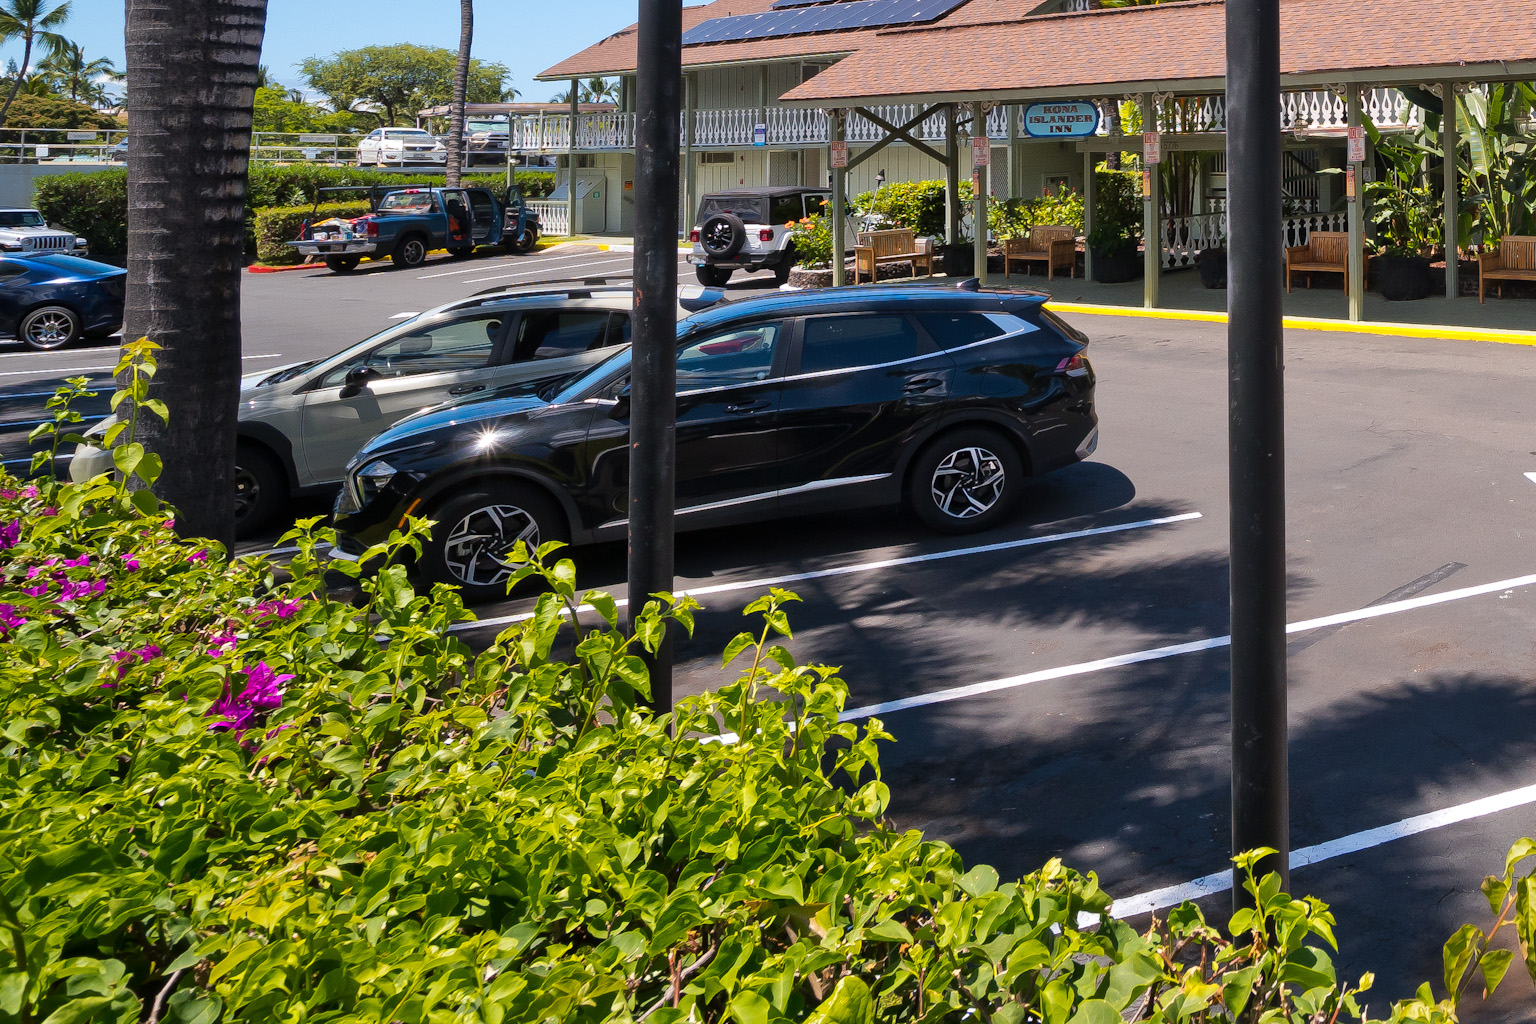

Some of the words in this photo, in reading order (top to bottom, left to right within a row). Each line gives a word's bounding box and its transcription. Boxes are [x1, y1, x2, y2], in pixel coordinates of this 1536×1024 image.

[1043, 105, 1078, 114] KONA
[1029, 115, 1093, 123] ISLANDER
[1049, 125, 1072, 133] INN
